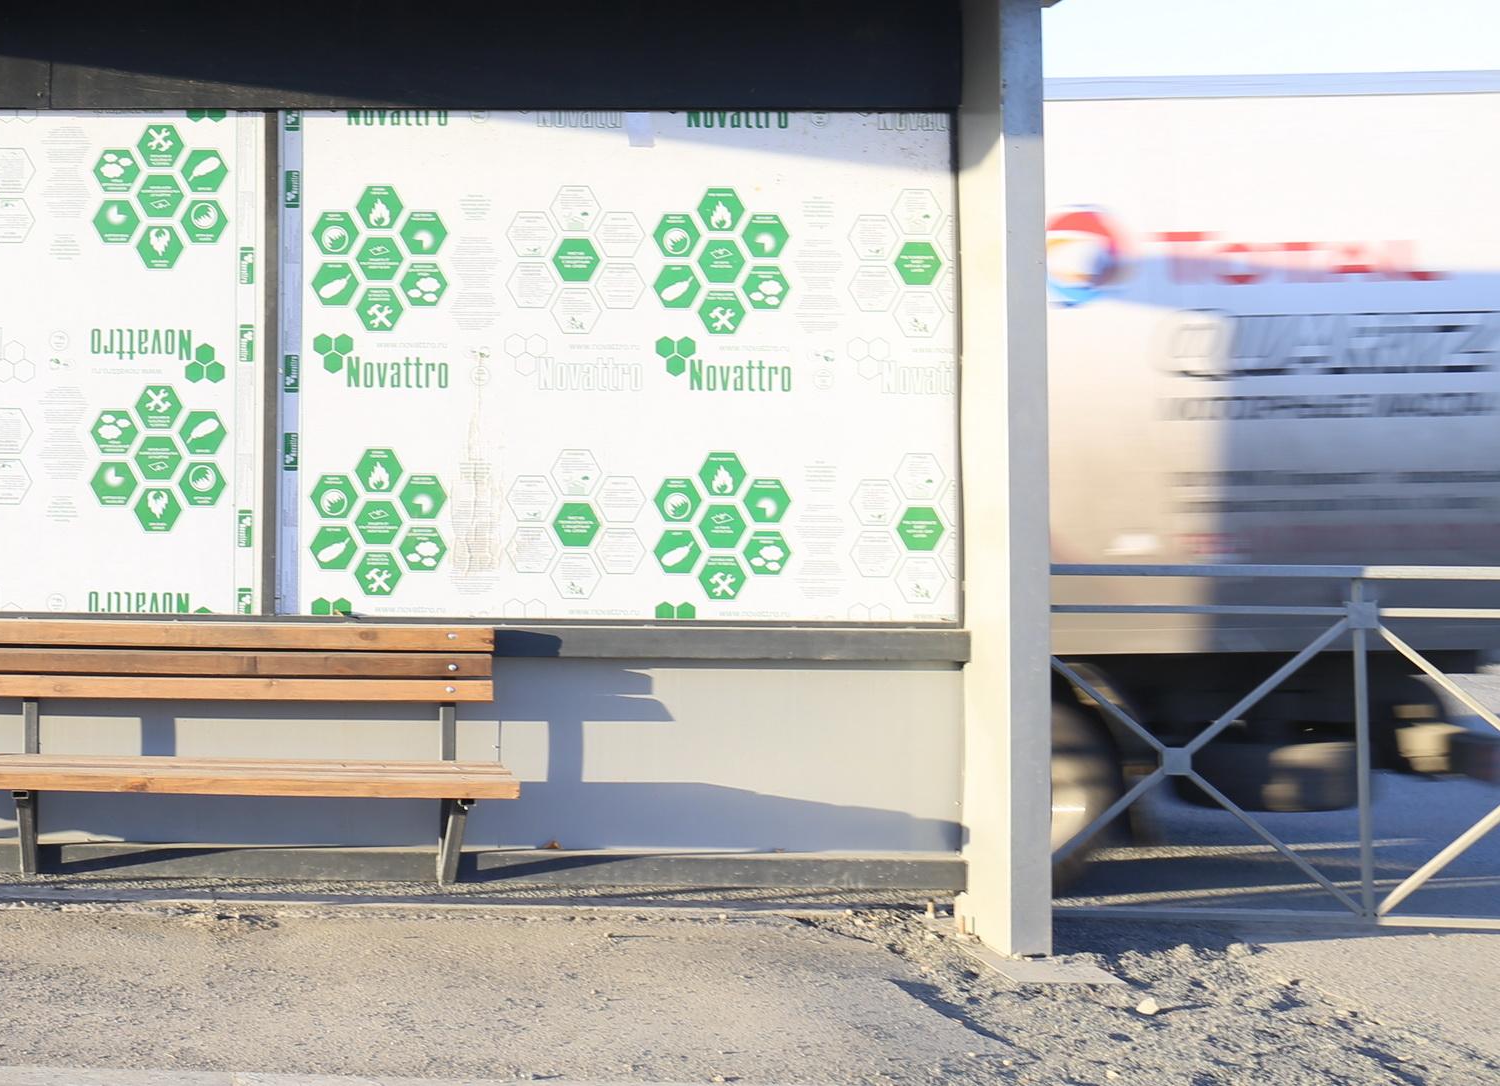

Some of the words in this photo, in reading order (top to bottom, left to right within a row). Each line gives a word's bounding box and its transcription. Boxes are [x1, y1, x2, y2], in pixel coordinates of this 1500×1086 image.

[91, 328, 192, 361] Novattro
[347, 356, 449, 389] Novattro
[689, 359, 792, 392] Novattro
